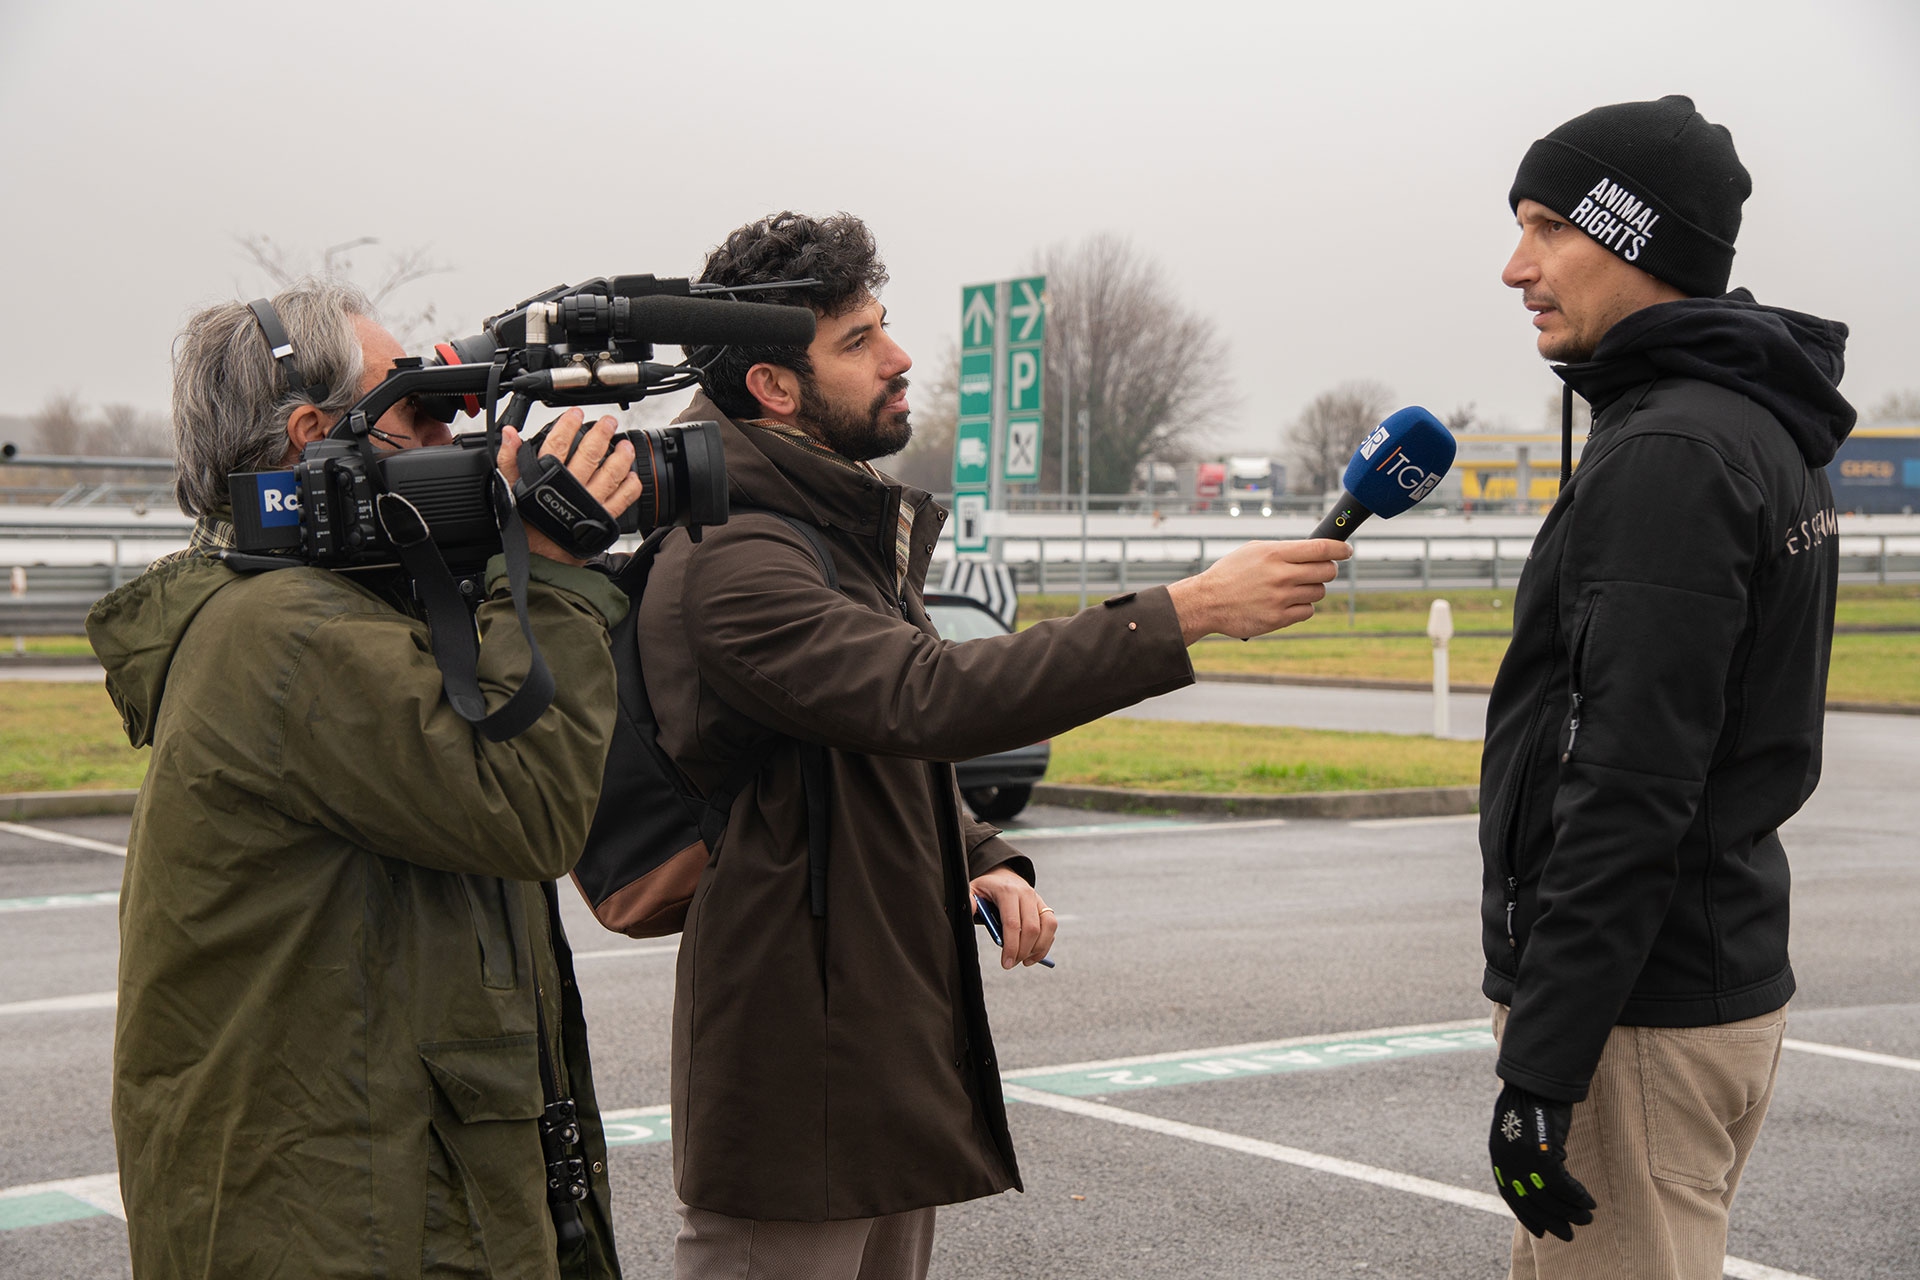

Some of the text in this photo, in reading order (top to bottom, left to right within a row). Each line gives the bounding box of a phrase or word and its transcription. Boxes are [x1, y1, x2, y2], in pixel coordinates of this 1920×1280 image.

[1569, 197, 1647, 261] RIGHTS
[1587, 177, 1660, 239] ANIMAL
[1011, 350, 1038, 409] P
[1386, 452, 1442, 502] TGR
[542, 493, 576, 522] SONY
[1087, 1070, 1159, 1085] 2
